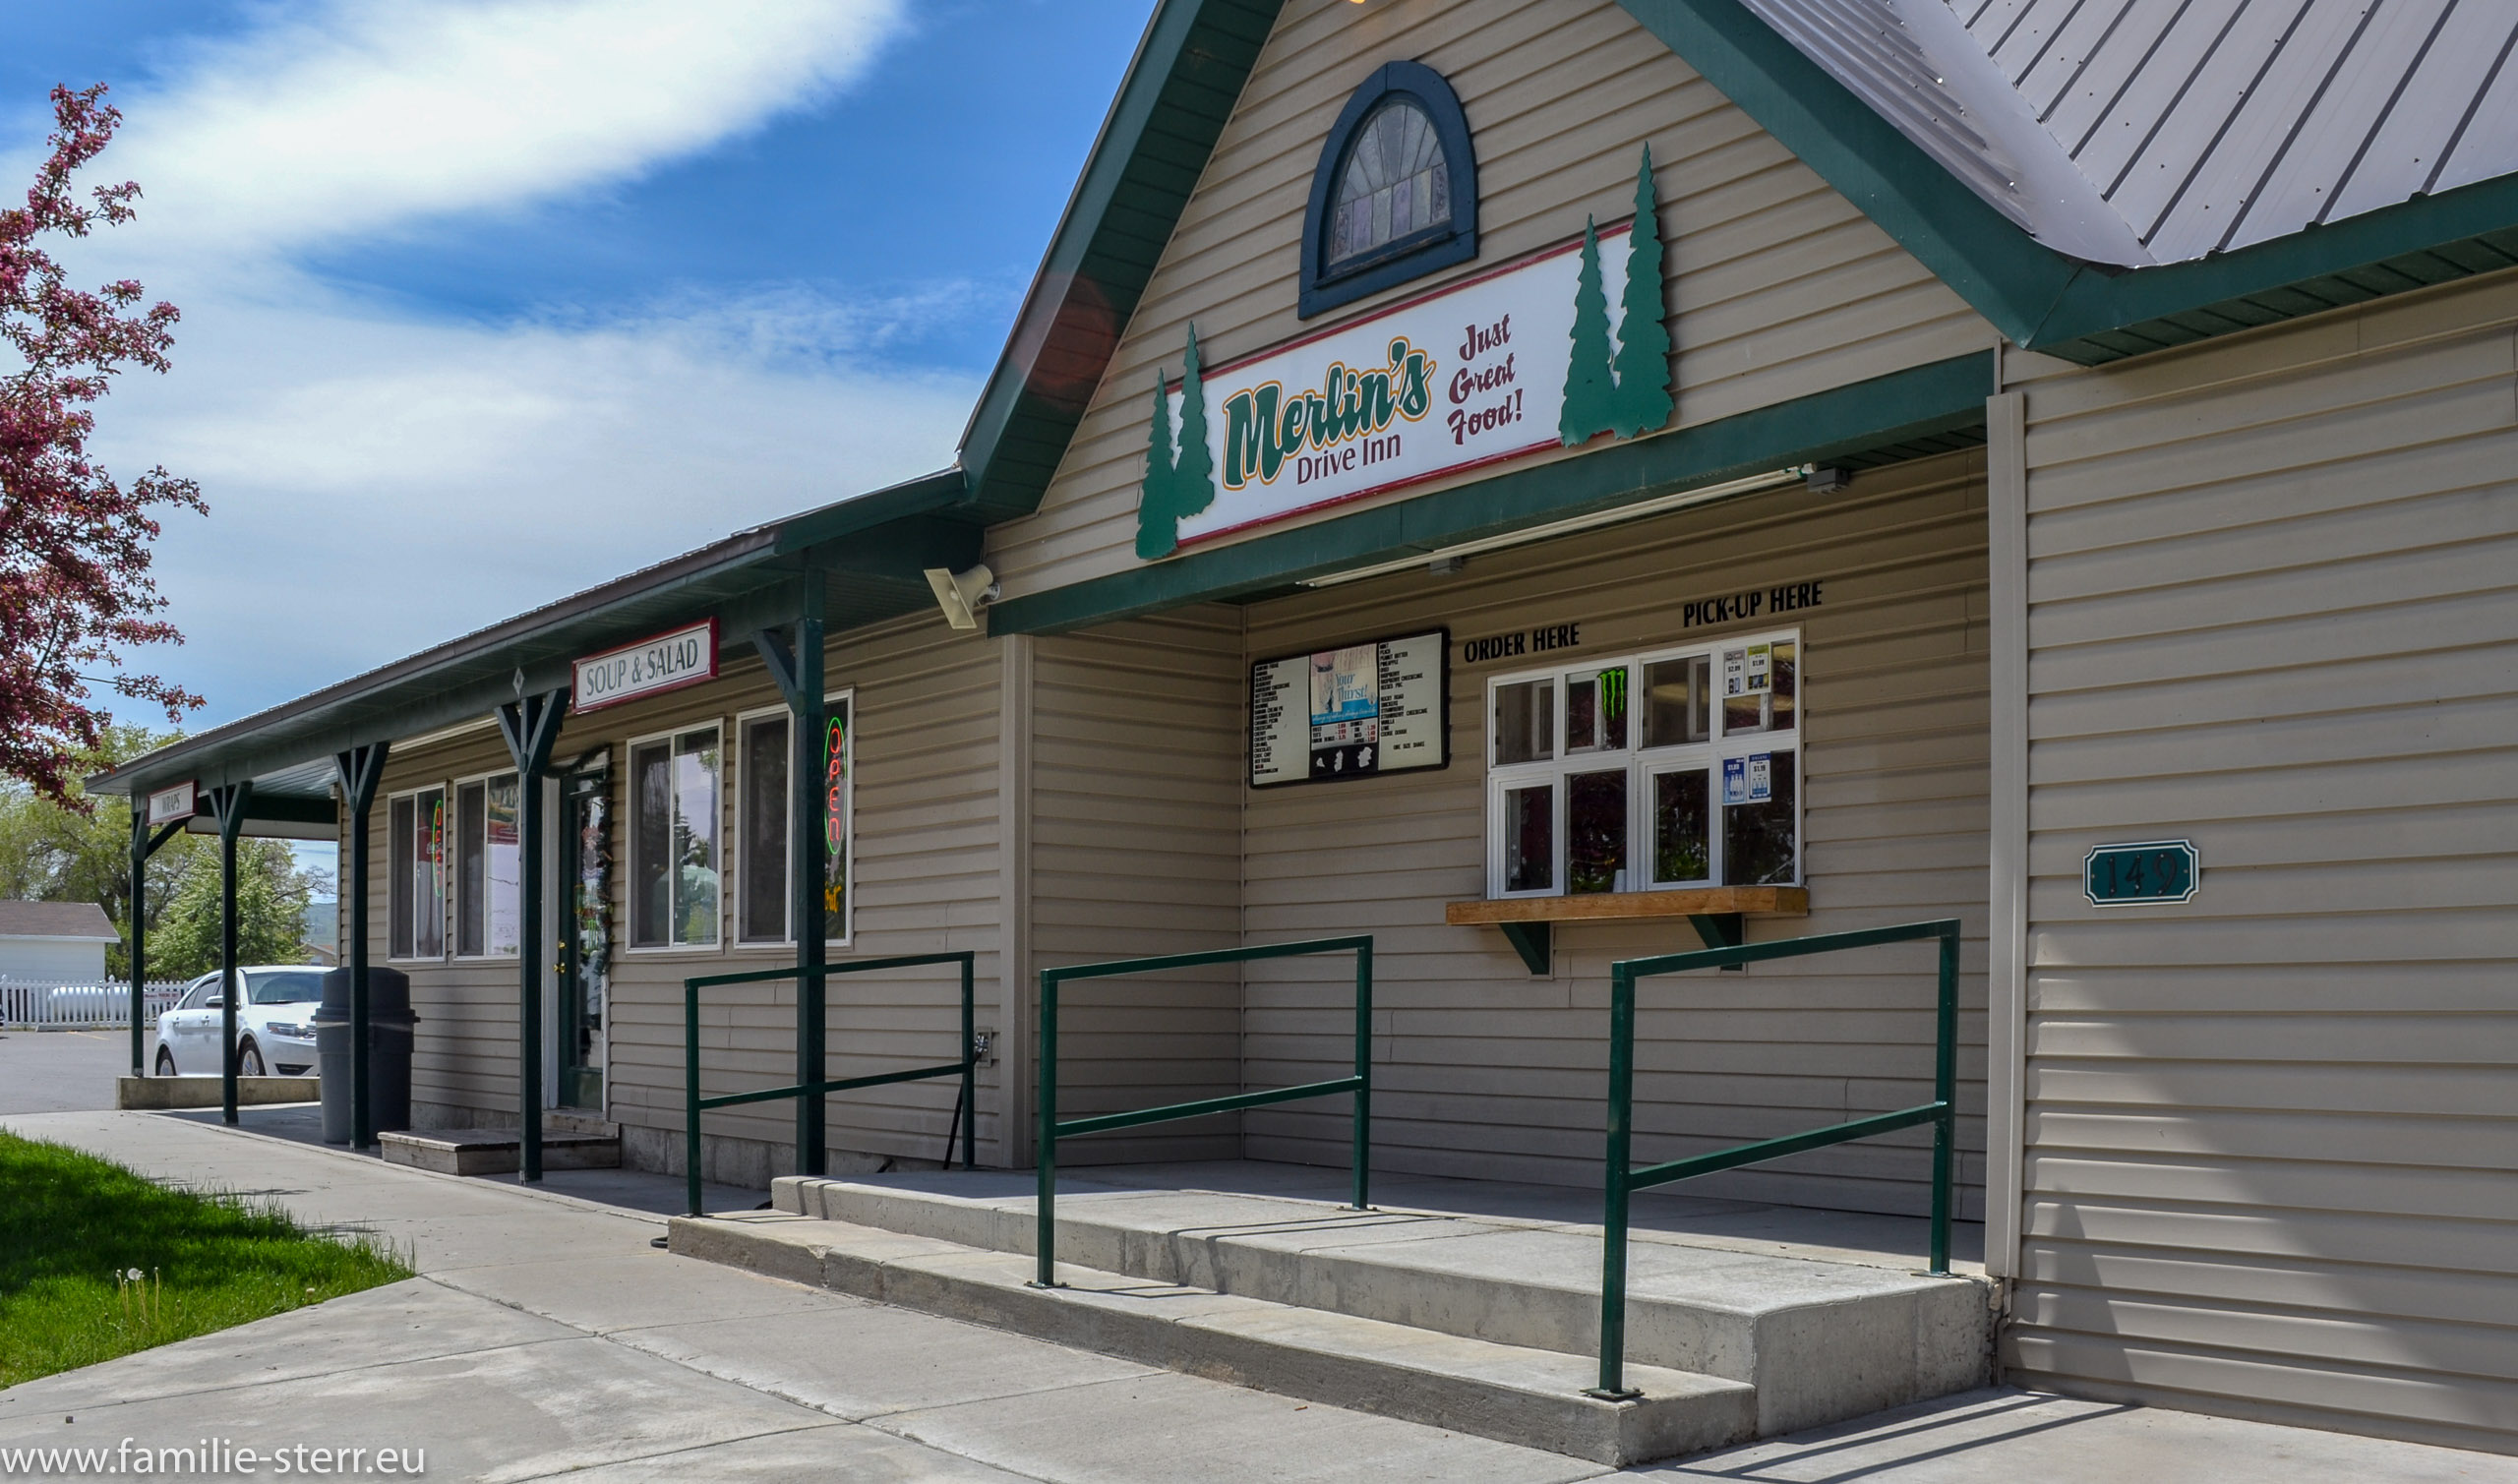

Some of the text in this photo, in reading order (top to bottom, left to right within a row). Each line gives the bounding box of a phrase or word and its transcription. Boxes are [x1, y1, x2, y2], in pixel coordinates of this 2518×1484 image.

[1459, 313, 1512, 361] Just
[1449, 352, 1516, 404] Great
[1224, 337, 1436, 490] Merlin's
[1447, 388, 1524, 445] Food!
[1296, 434, 1402, 486] Drive Inn
[1683, 580, 1824, 627] PICK-UP HERE
[586, 638, 698, 696] SOUP & SALAD
[1464, 622, 1580, 663] ORDER HERE
[1335, 673, 1355, 685] Your
[1338, 684, 1367, 701] Thirst!
[829, 728, 840, 841] OPEN
[2107, 852, 2177, 897] 149
